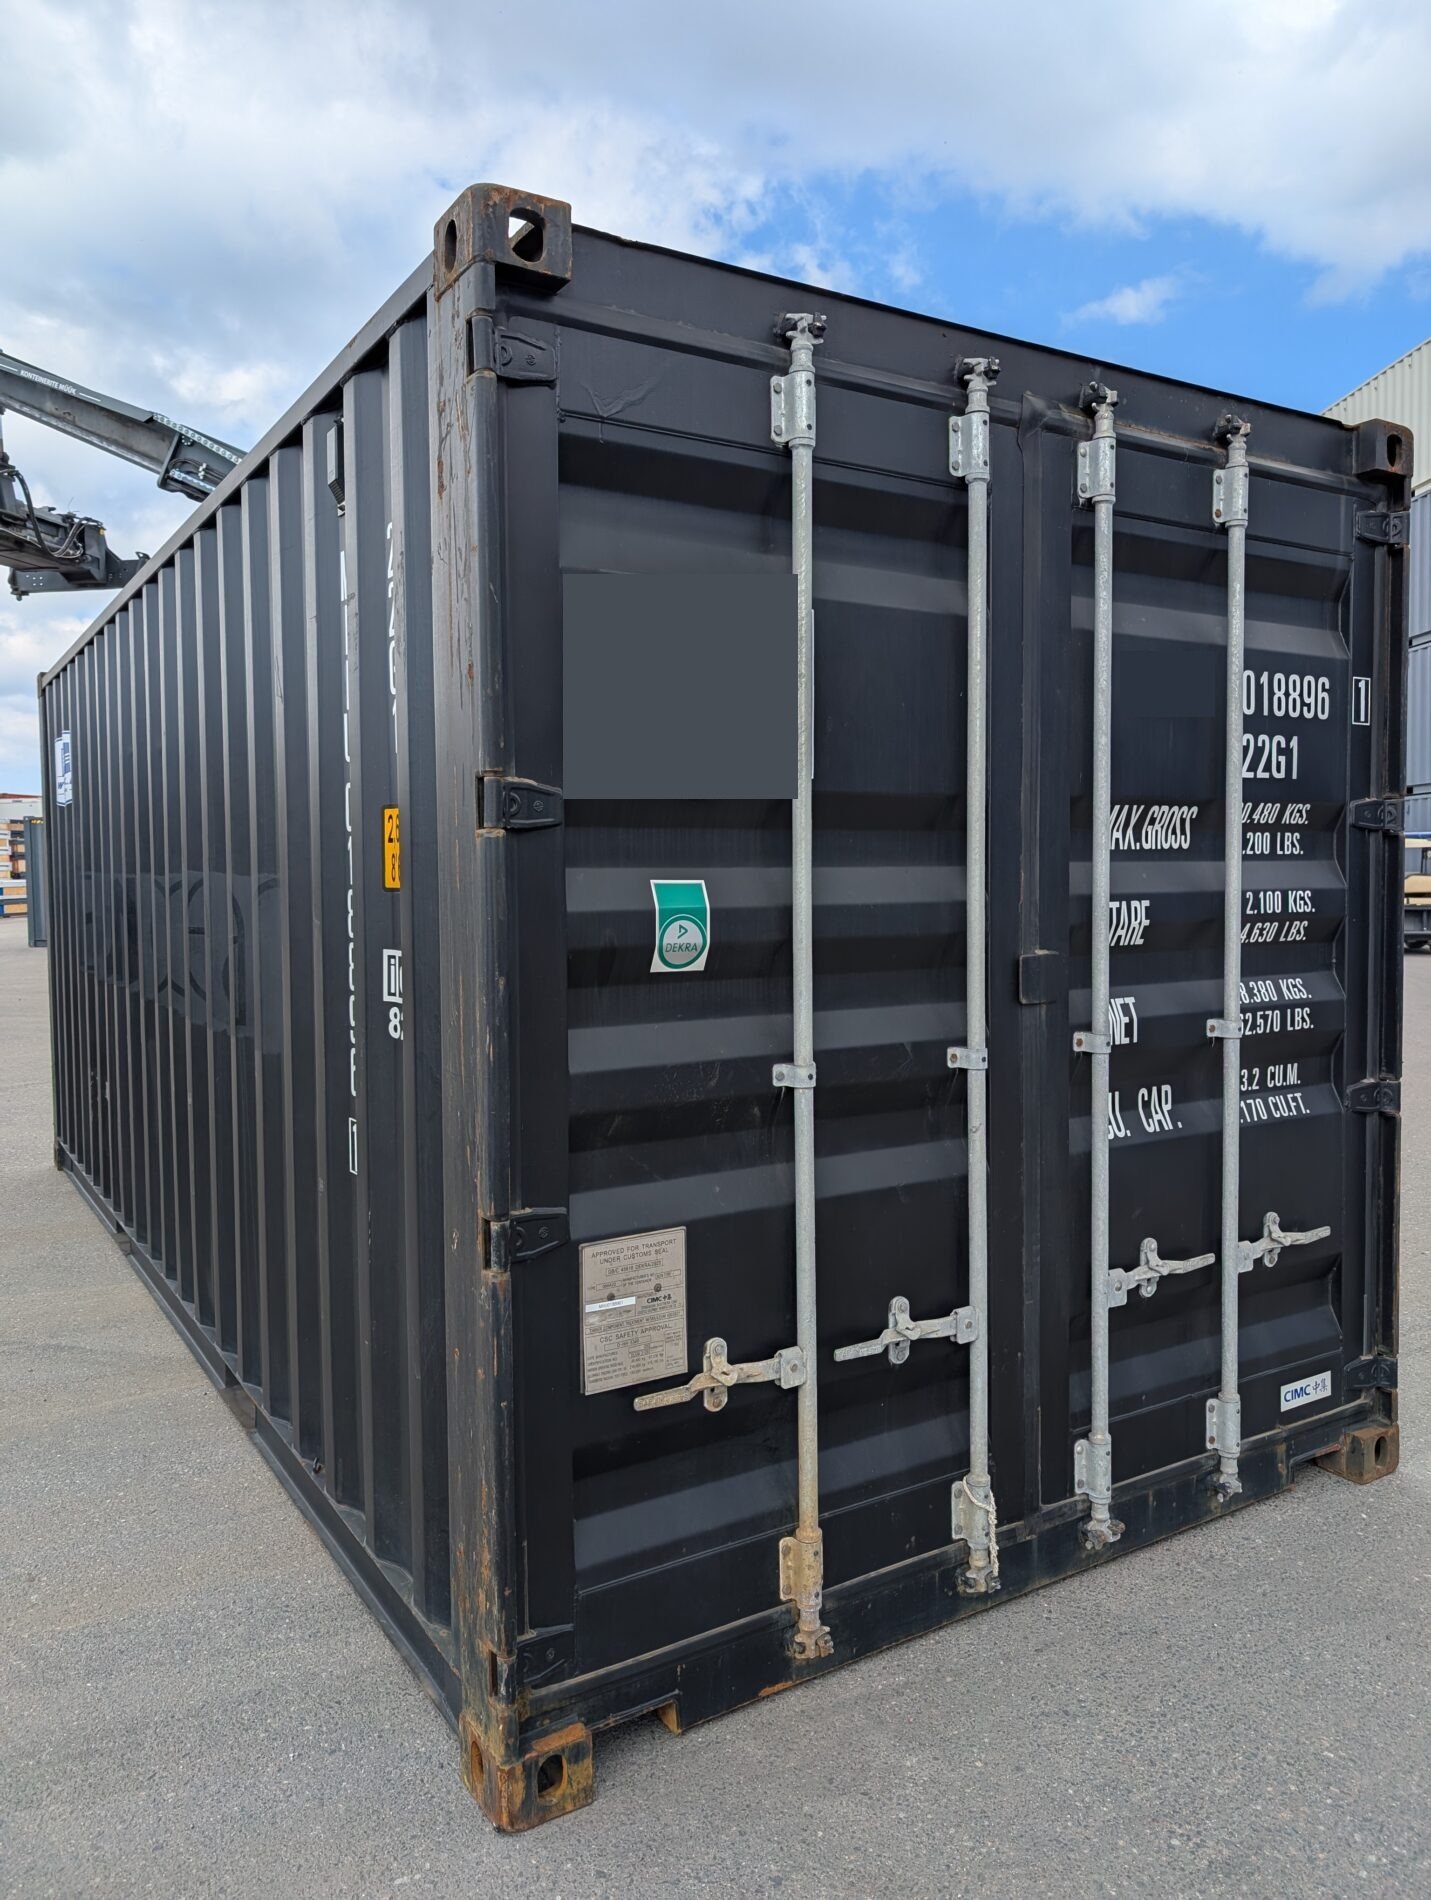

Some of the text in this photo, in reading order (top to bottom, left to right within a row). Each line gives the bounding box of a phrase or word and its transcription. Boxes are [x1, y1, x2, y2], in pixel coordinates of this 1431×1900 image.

[1242, 669, 1330, 720] 018896
[1241, 733, 1299, 780] 22G1
[1281, 803, 1311, 825] KGS.
[1276, 832, 1304, 855] LBS.
[1109, 899, 1151, 947] TARE
[1288, 889, 1316, 913] KGS.
[1279, 920, 1309, 942] LBS.
[664, 942, 698, 953] DEKRA
[1109, 996, 1138, 1046] NET
[1278, 977, 1312, 1001] KGS.
[1286, 1007, 1315, 1031] LBS.
[1137, 1084, 1183, 1133] CAP.
[1266, 1062, 1301, 1088] CU.M.
[1267, 1092, 1311, 1118] CU.FT.
[591, 1247, 625, 1259] APPROVED
[642, 1238, 677, 1249] TRANSPORT
[599, 1247, 669, 1265] UNDER CUSTOMS SEAL
[599, 1335, 613, 1343] CSC
[615, 1329, 639, 1340] SAFETY
[640, 1323, 673, 1334] APPROVAL
[1283, 1384, 1311, 1403] CIMC
